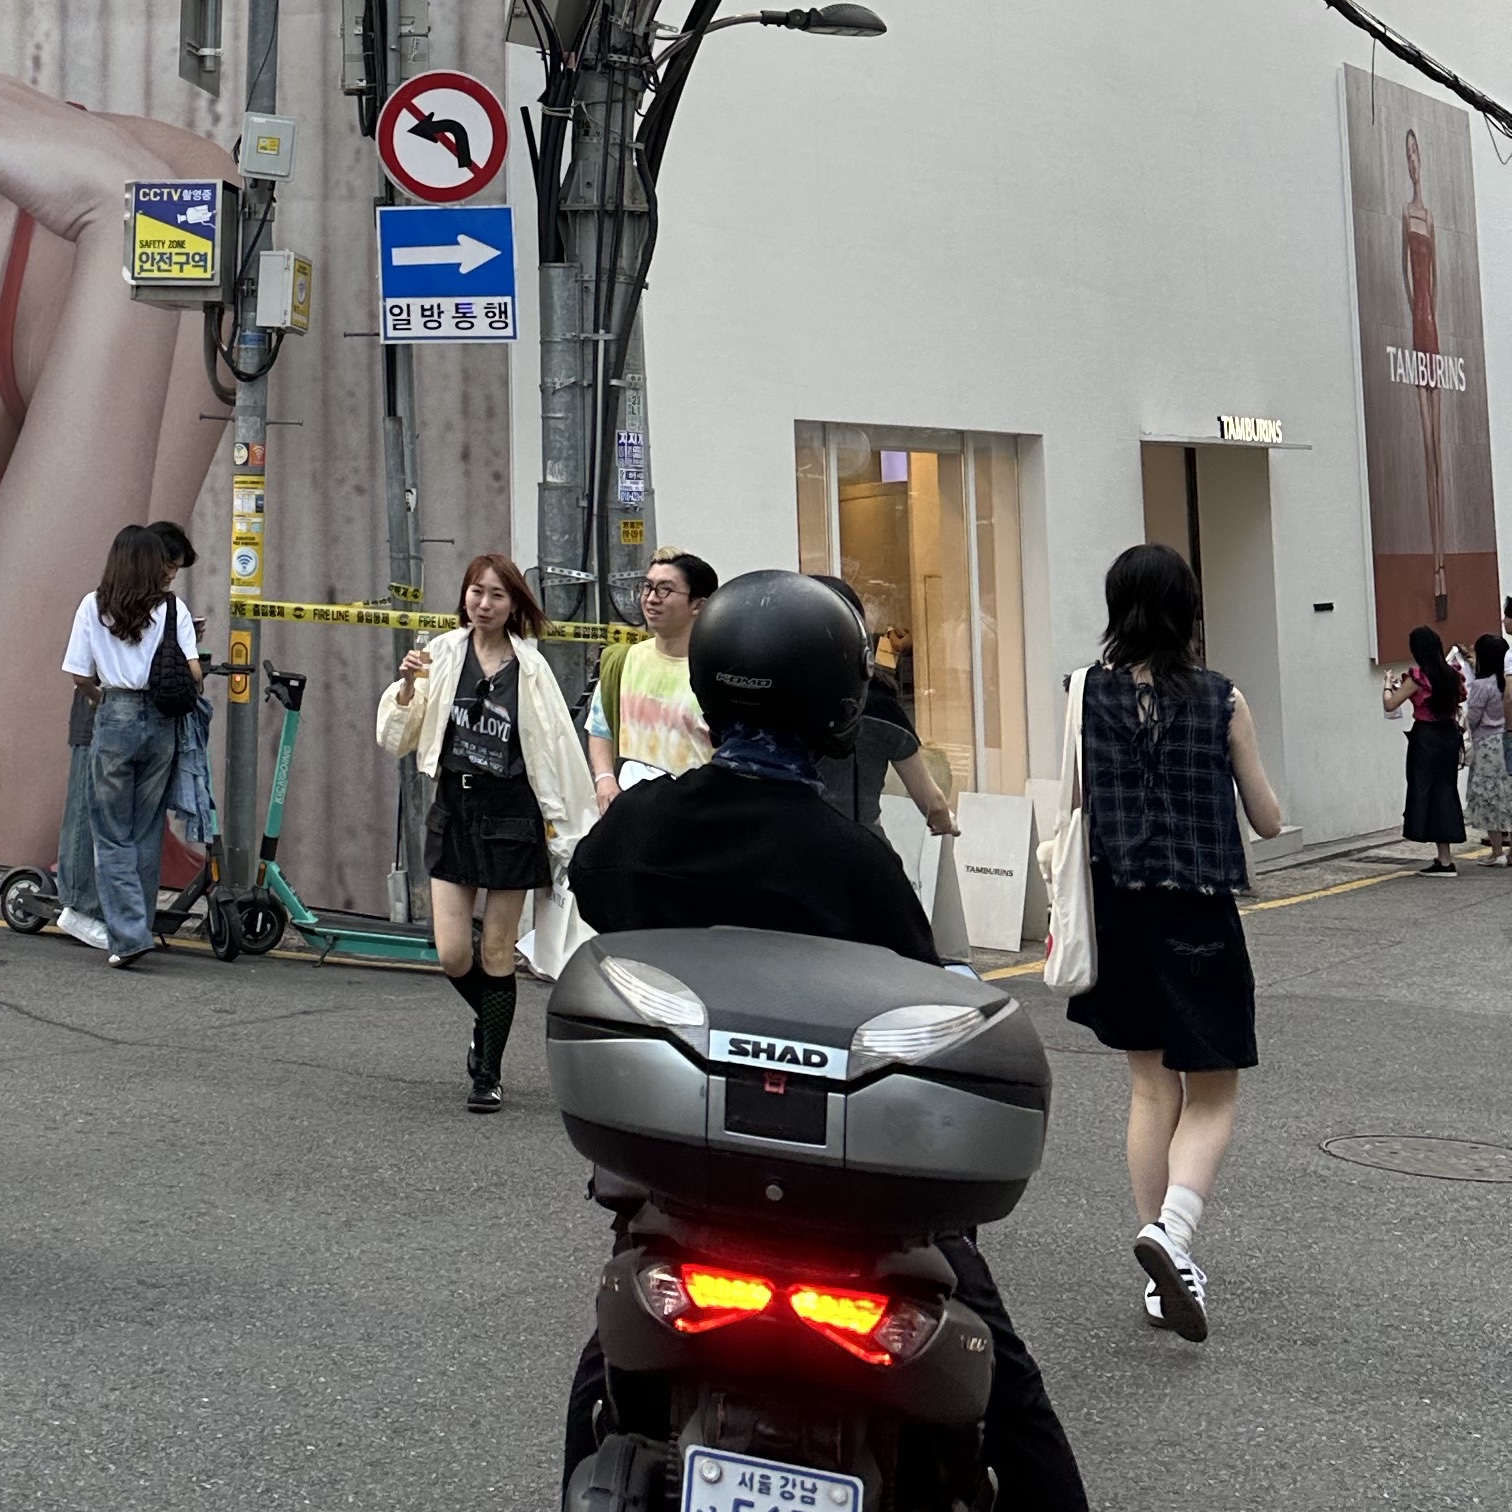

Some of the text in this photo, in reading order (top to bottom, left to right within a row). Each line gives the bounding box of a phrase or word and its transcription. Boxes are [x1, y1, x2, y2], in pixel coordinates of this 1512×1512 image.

[139, 188, 182, 201] CCTV
[139, 239, 186, 249] SAFETY ZONE
[138, 251, 208, 274] 안전구역
[389, 301, 509, 331] 일방통행
[1386, 345, 1466, 392] TAMBURINS
[1219, 415, 1282, 444] TAMBURINS
[313, 608, 331, 621] FIRE
[331, 609, 350, 623] LINE
[418, 615, 437, 628] FIRE
[438, 616, 457, 630] LINE
[479, 715, 511, 742] LOYD
[965, 865, 1014, 877] TAMBURINS
[728, 1037, 828, 1068] SHAD
[738, 1471, 772, 1496] 서울
[779, 1475, 818, 1505] 강남
